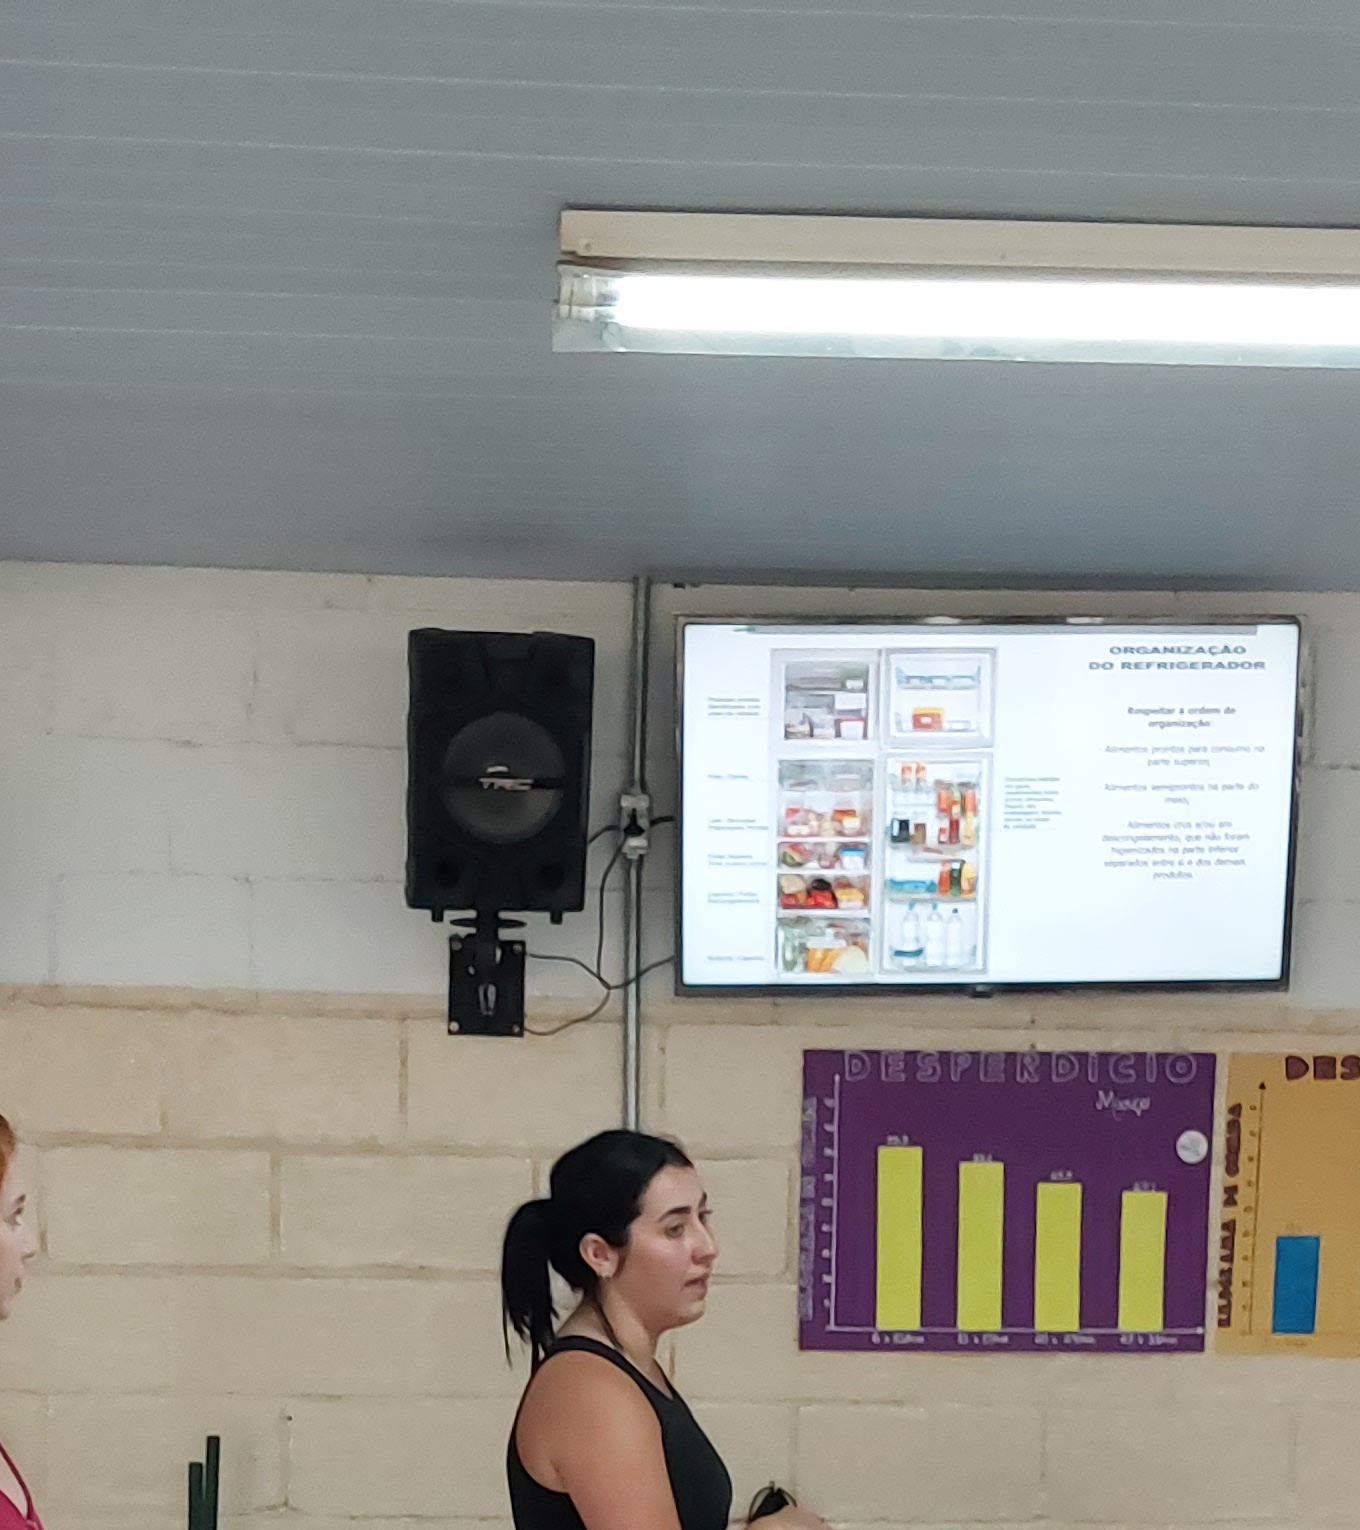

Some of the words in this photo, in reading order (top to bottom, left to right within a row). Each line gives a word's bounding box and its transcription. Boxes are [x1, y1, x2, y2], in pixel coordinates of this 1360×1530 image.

[1109, 644, 1247, 656] ORGANIZAÇÃO
[1088, 661, 1115, 670] DO
[1120, 661, 1266, 670] REFRIGERADOR
[844, 1050, 1198, 1083] DESPERDICIO
